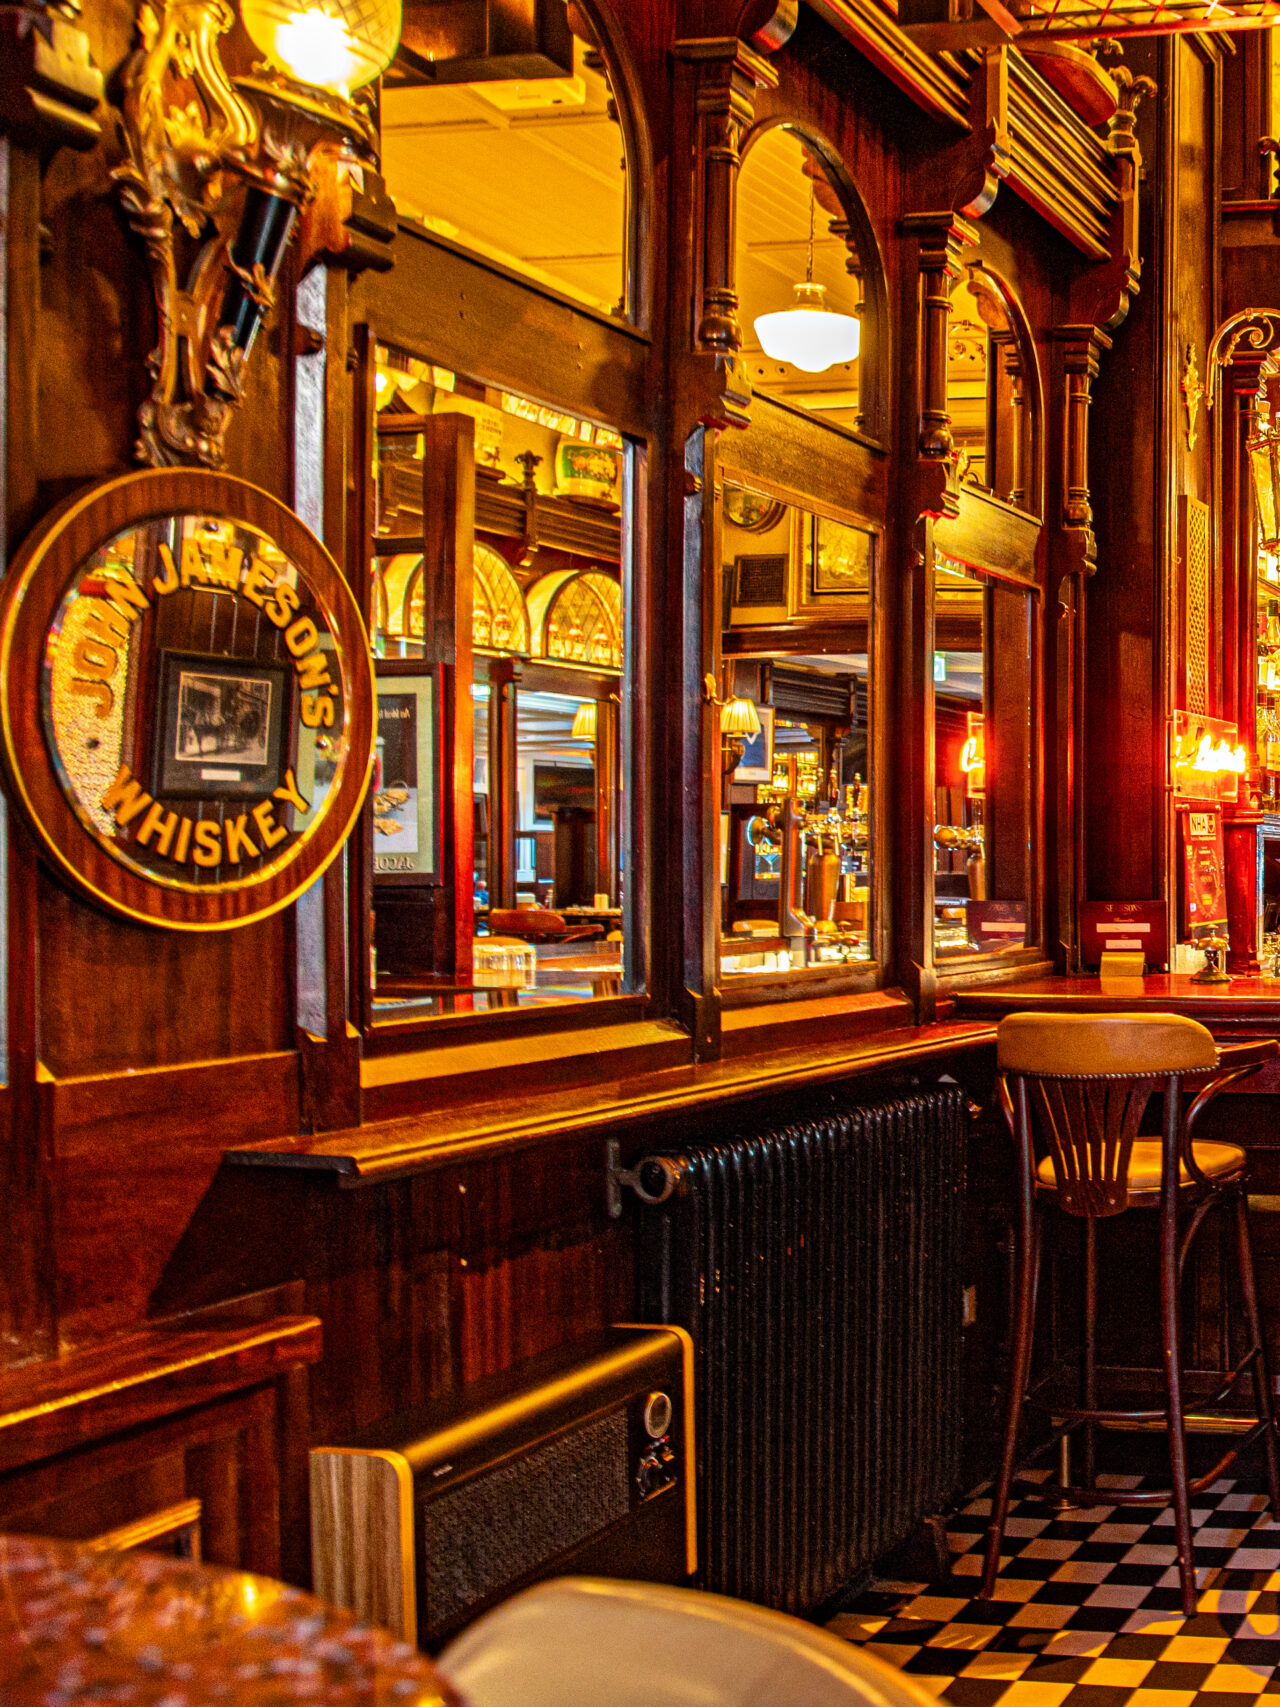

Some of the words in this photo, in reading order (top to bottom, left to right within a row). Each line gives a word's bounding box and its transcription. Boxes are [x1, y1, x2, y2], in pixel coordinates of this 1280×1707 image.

[72, 567, 151, 720] JOHN
[152, 541, 336, 729] JAMESON'S
[101, 763, 312, 869] WHISKEY
